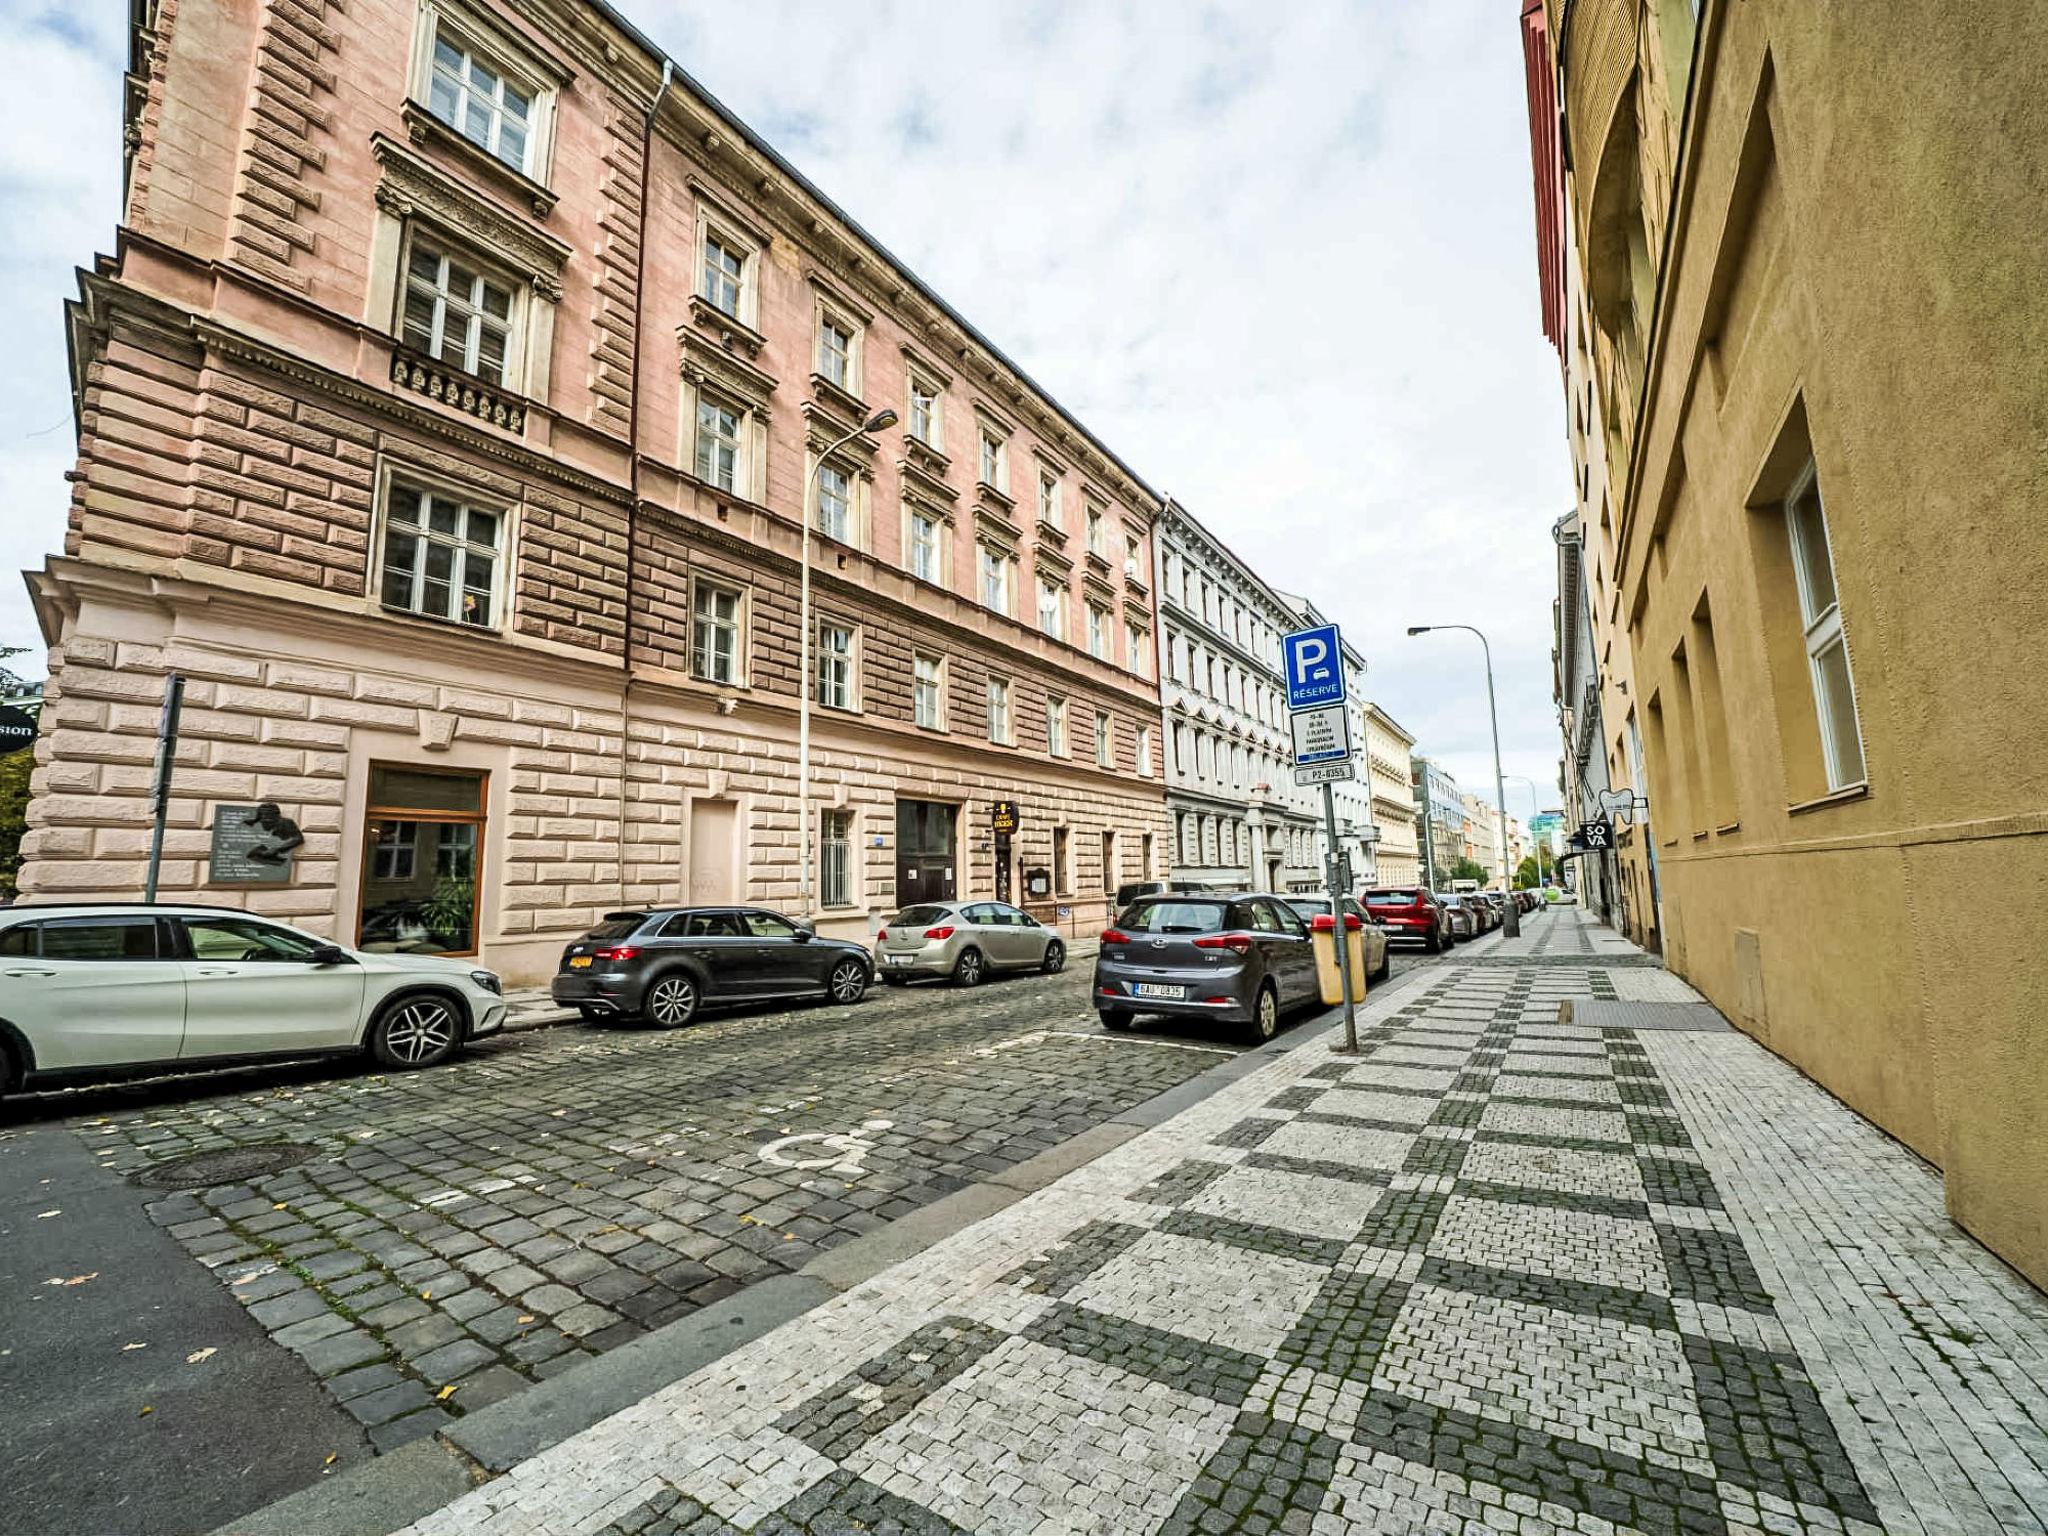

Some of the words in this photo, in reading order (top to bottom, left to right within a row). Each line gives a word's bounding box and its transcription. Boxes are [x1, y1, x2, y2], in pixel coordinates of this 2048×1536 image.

[1295, 638, 1327, 684] P
[1586, 825, 1605, 835] SO
[1587, 836, 1607, 846] VA
